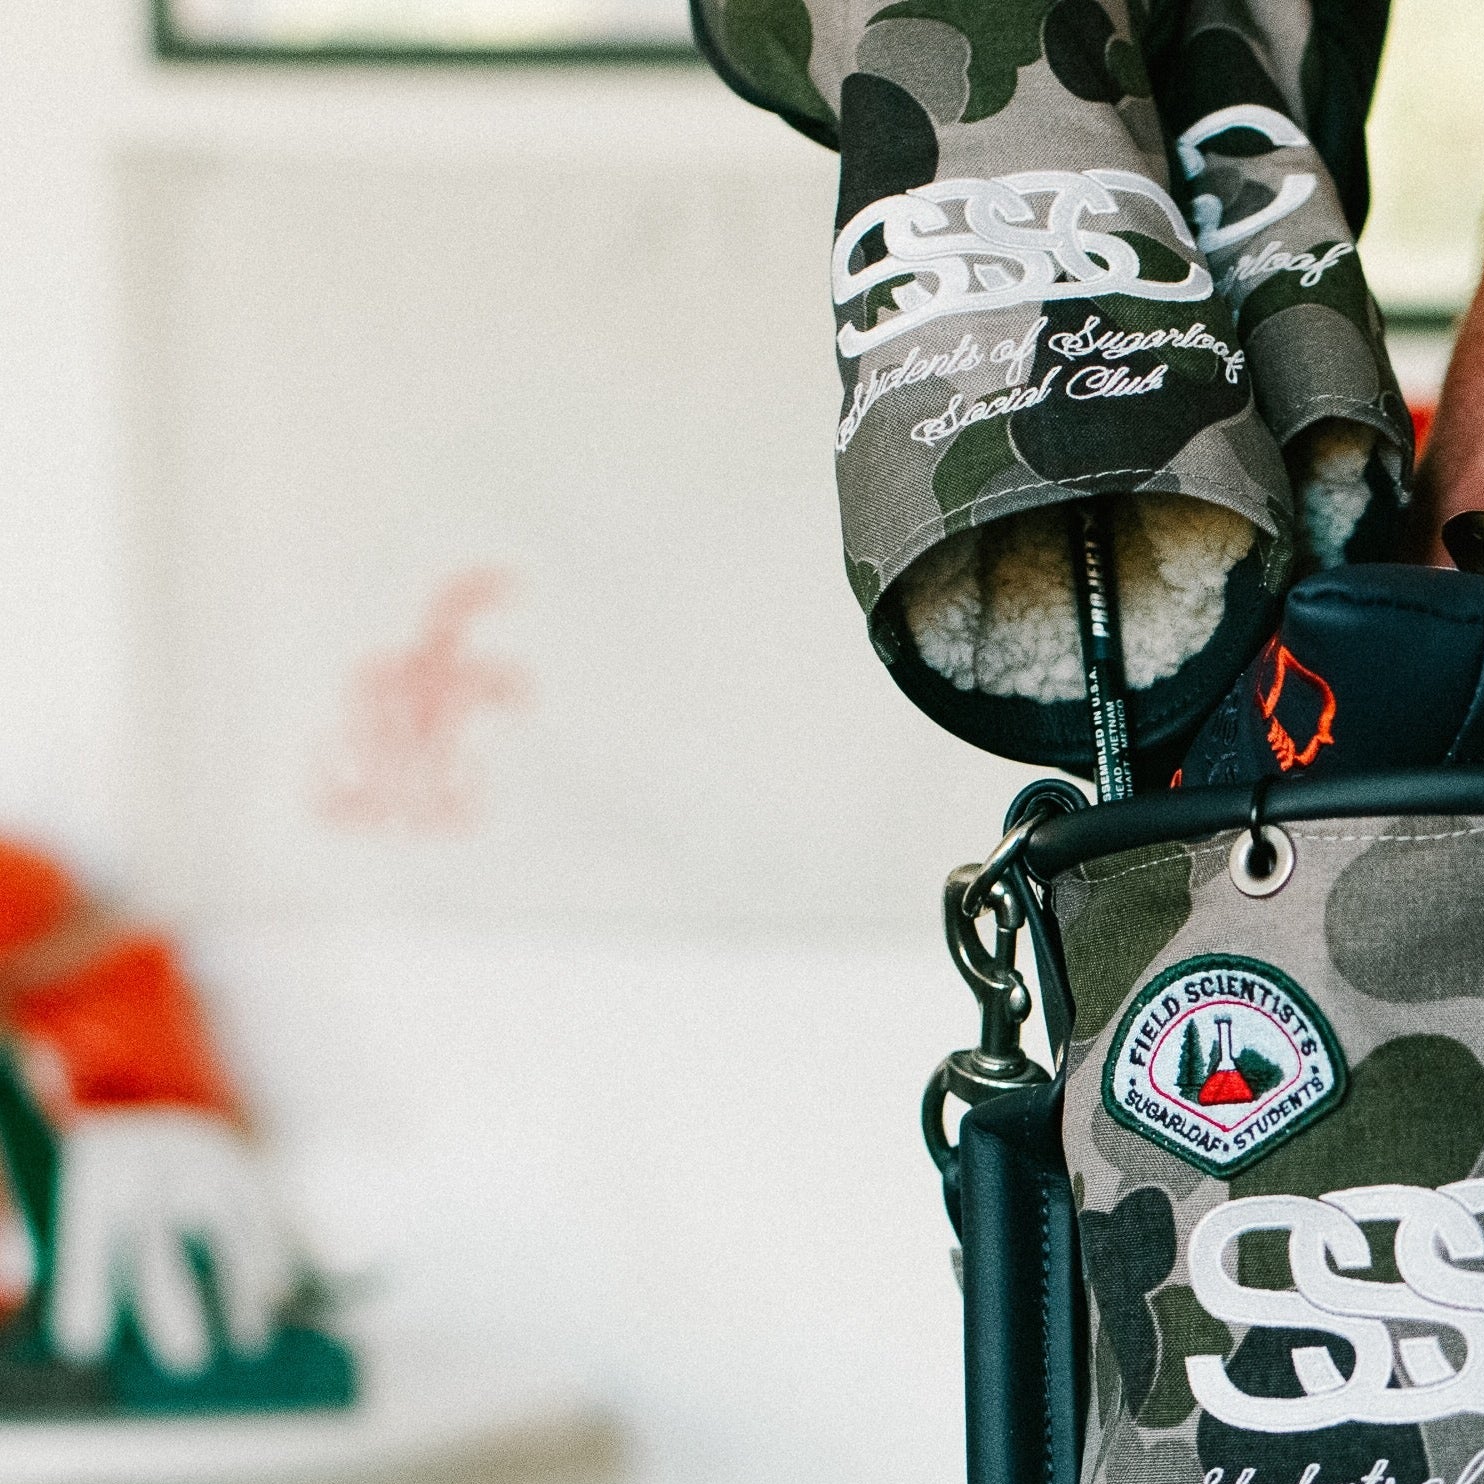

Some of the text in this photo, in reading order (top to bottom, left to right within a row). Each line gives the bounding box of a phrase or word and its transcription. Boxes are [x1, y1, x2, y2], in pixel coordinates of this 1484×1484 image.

[993, 316, 1049, 383] of
[1048, 316, 1245, 384] Sugarloaf
[911, 363, 1168, 445] Social Club
[1095, 728, 1111, 802] SSEMBLED
[1105, 701, 1120, 755] VIETNAM
[1130, 975, 1317, 1066] FIELD SCIENTISTS
[1125, 1077, 1323, 1151] SUGARLOAF STUDENTS
